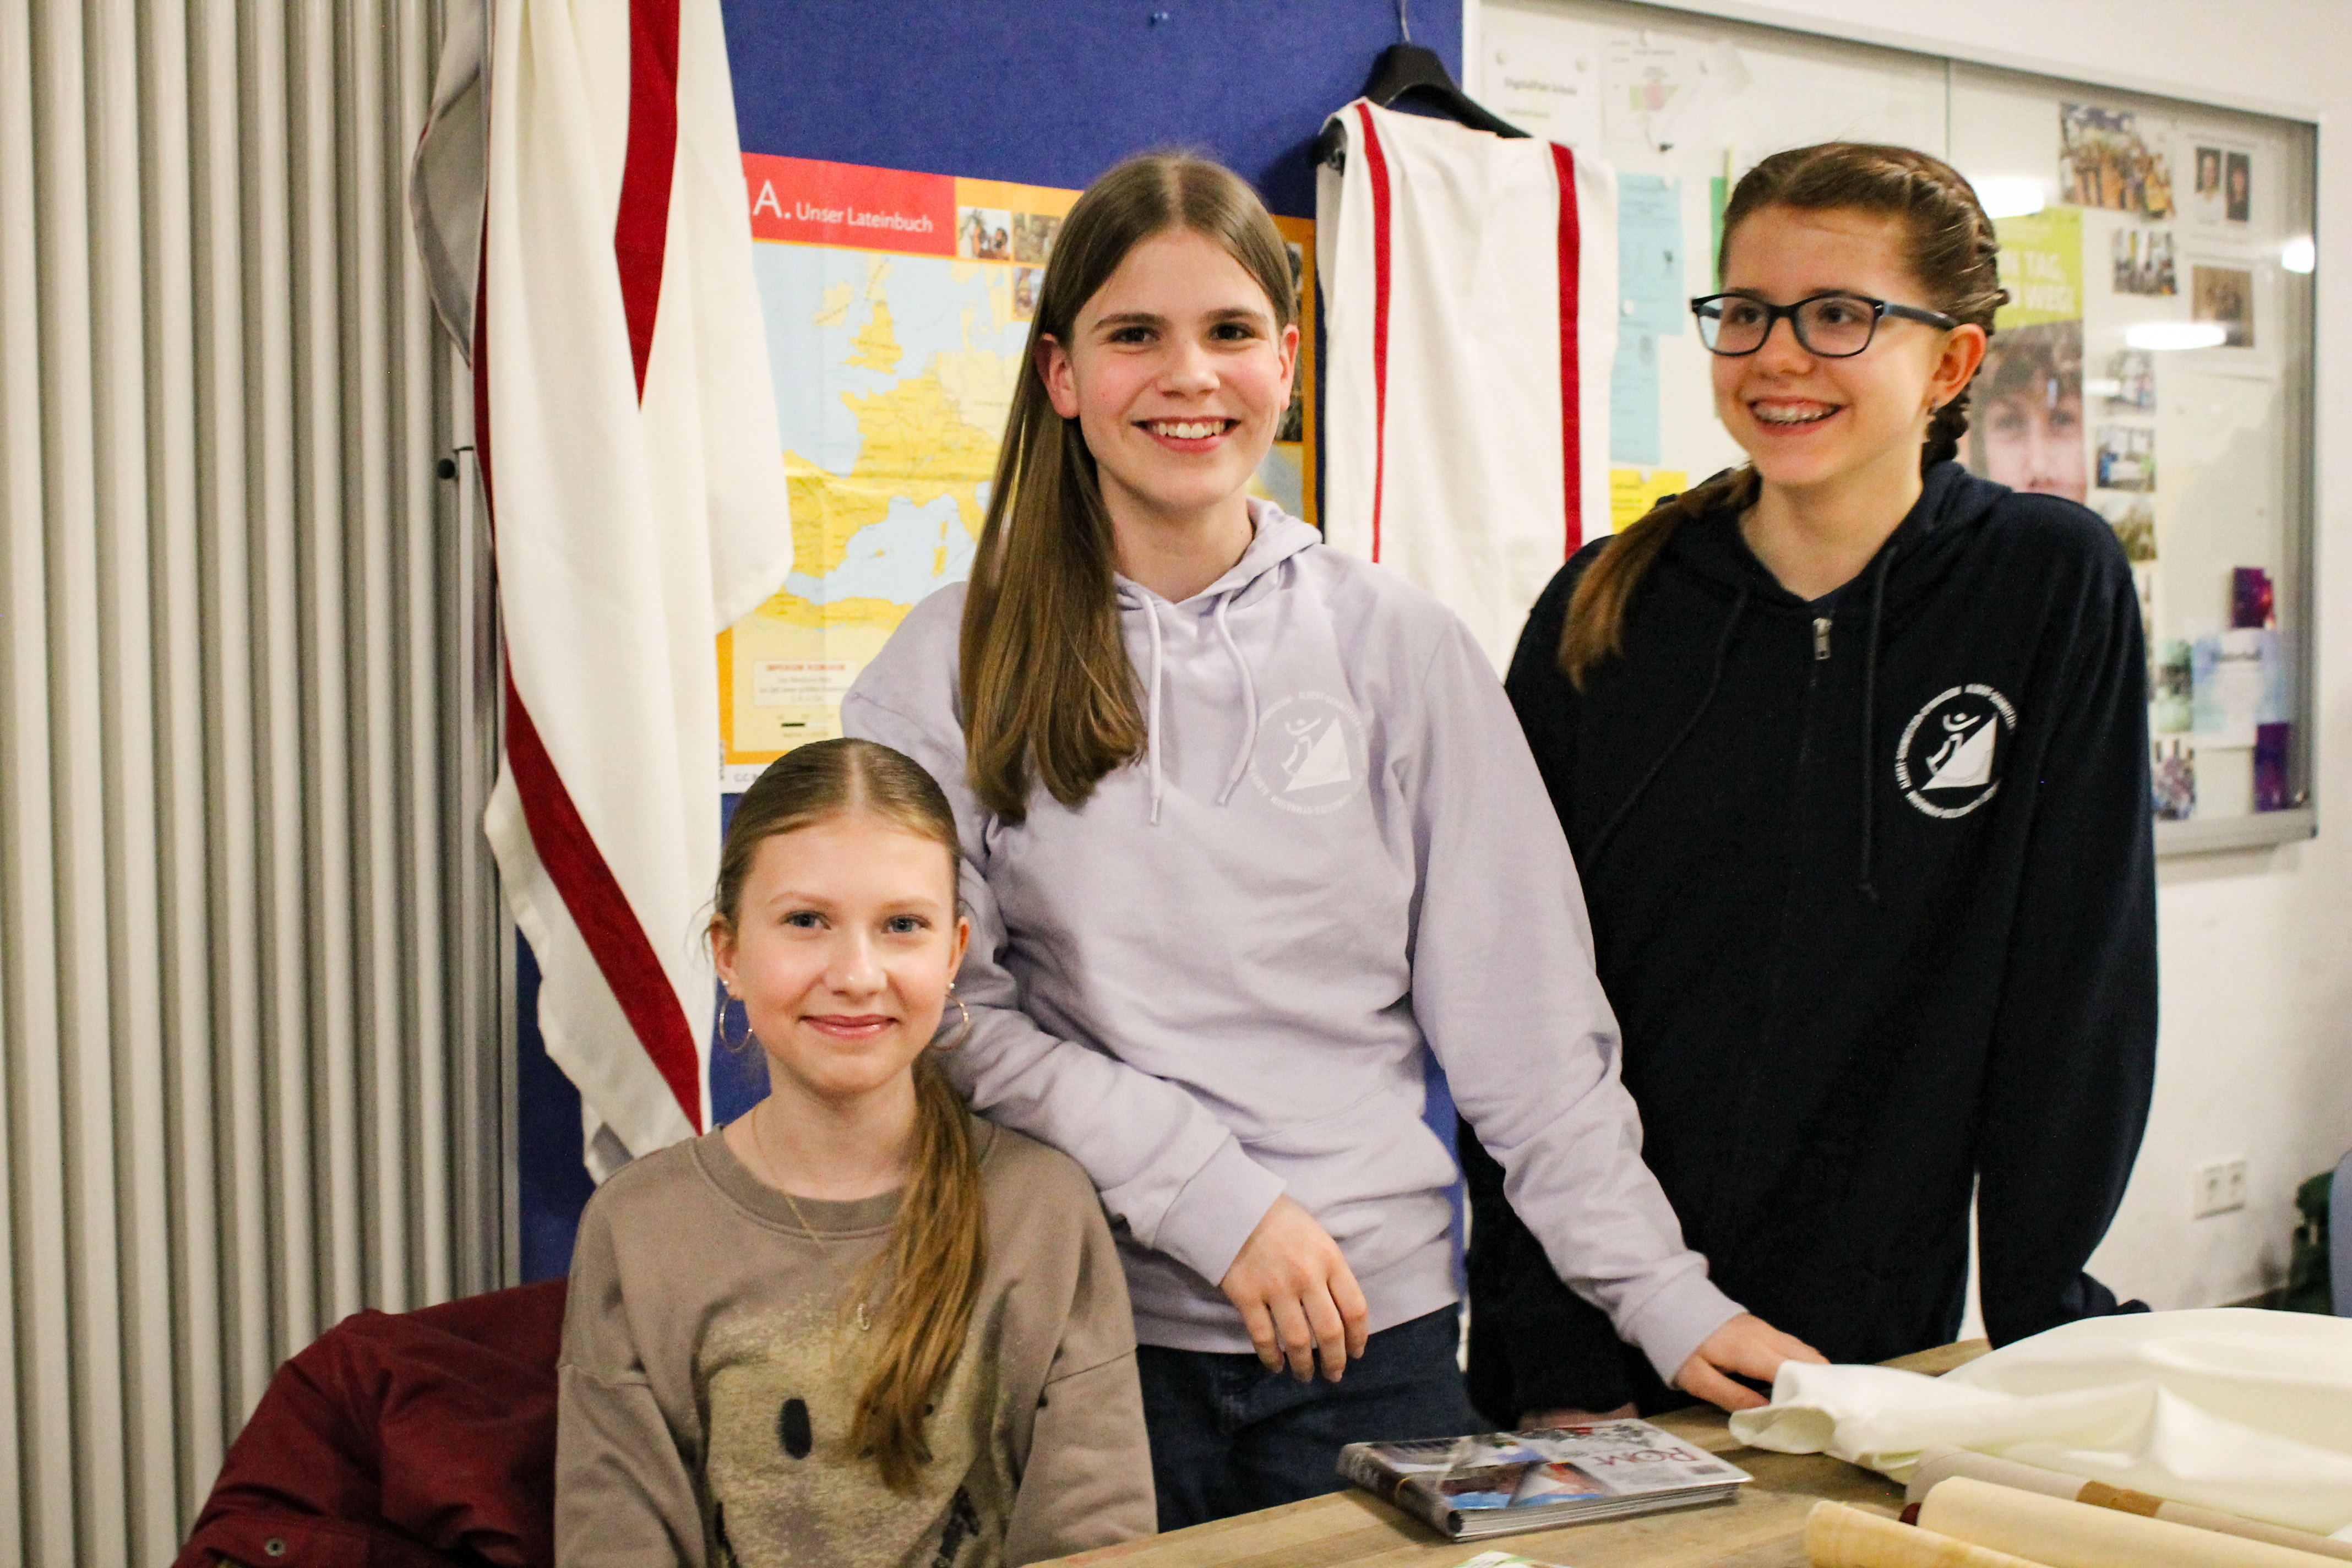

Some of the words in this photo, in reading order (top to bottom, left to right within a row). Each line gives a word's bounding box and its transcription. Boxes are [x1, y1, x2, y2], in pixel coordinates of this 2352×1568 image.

[753, 179, 791, 219] A.
[796, 202, 844, 223] Unser
[847, 206, 933, 233] Lateinbuch
